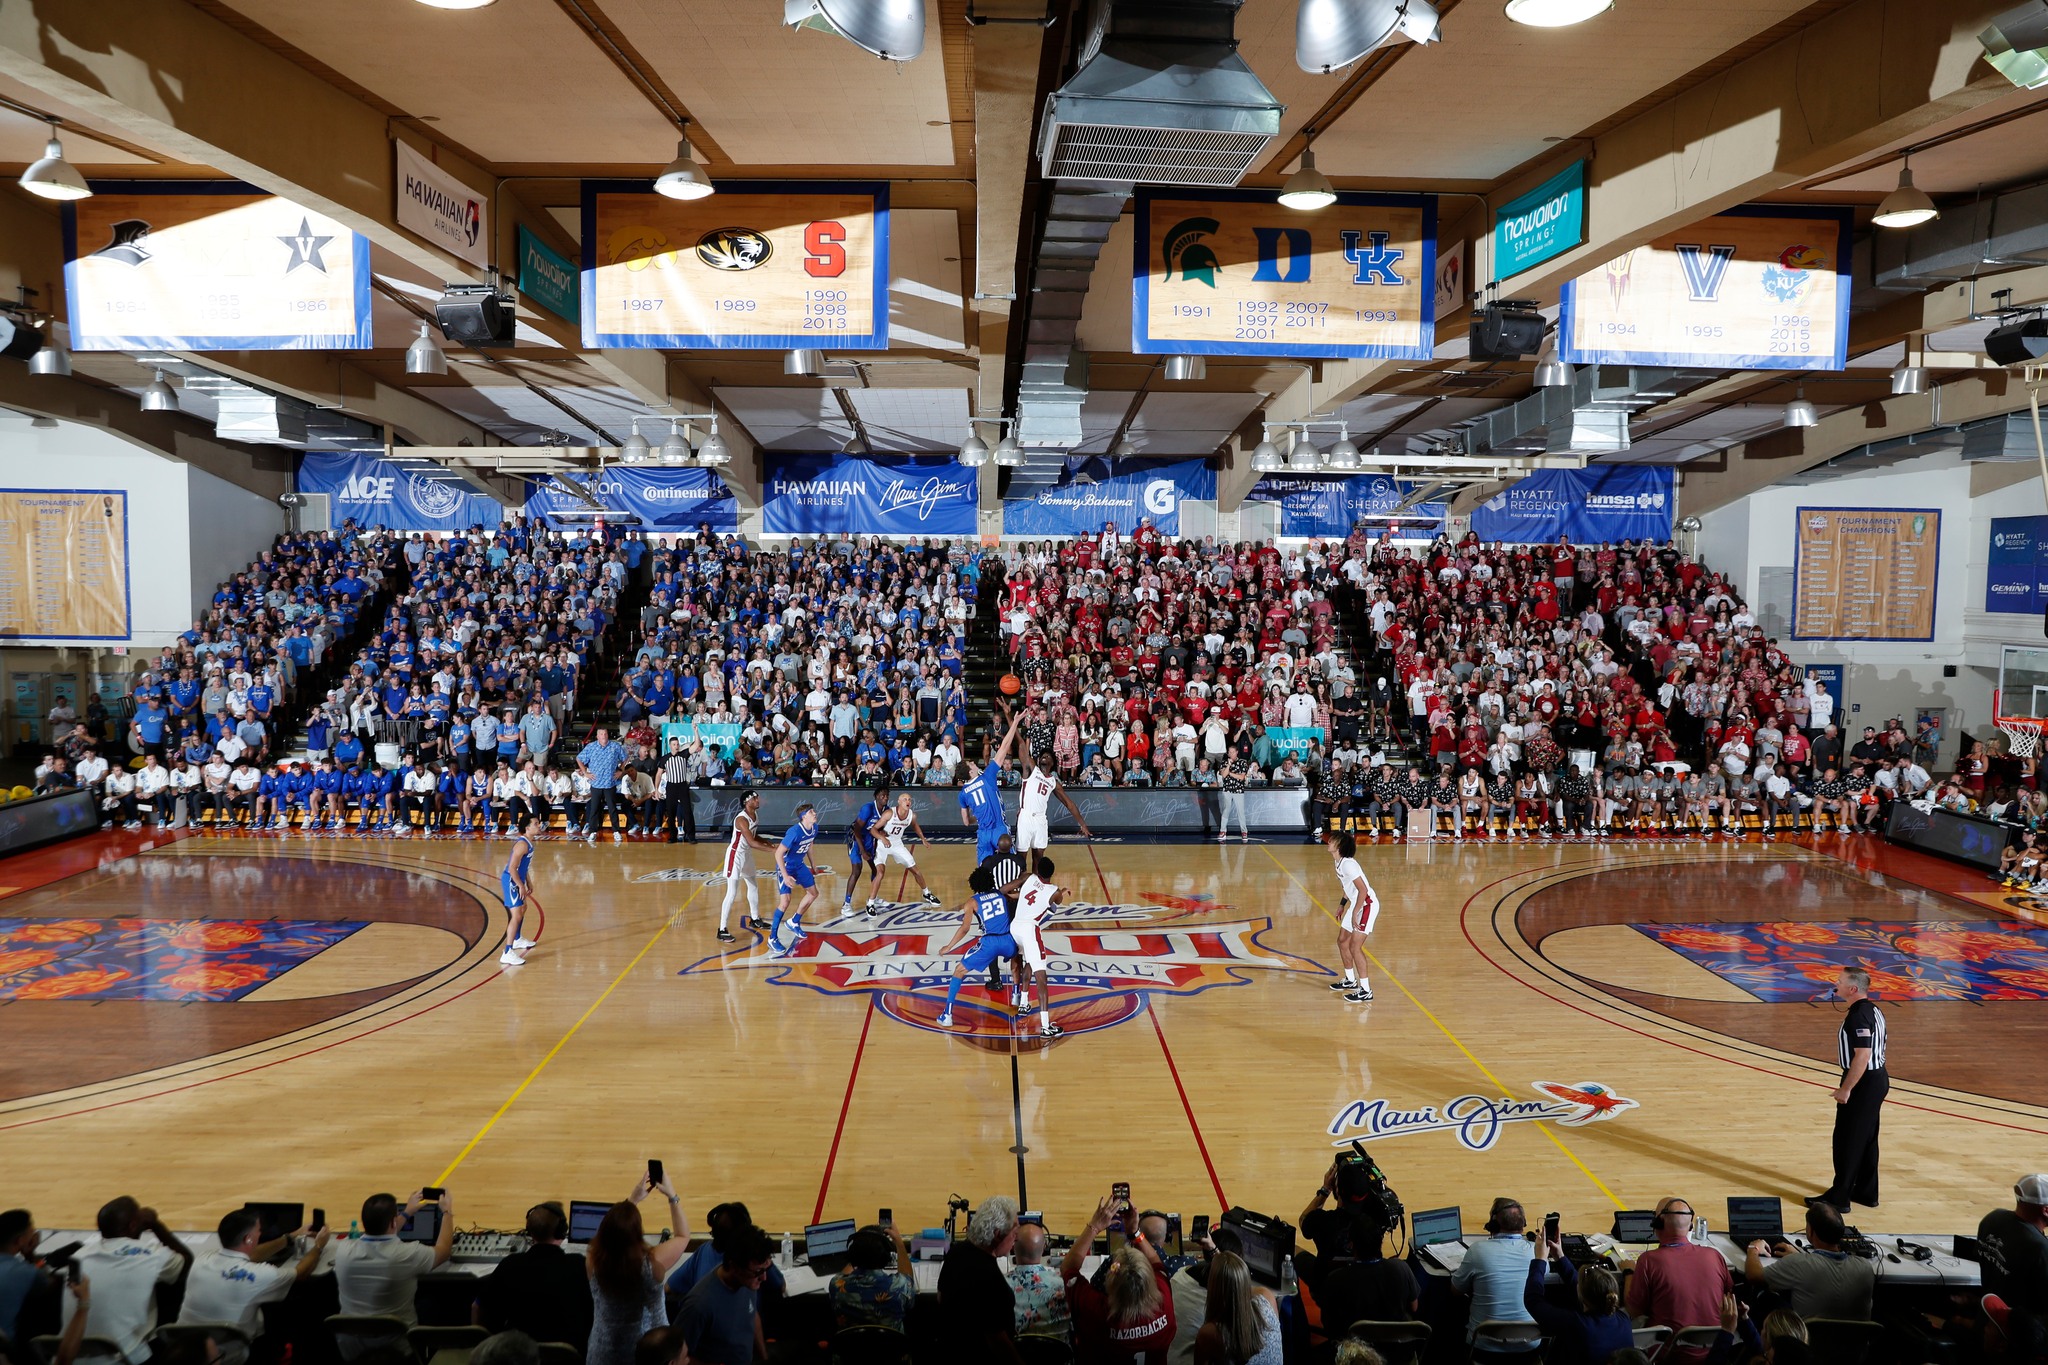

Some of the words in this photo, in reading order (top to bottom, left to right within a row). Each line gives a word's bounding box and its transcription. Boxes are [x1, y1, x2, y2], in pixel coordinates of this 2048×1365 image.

[405, 173, 465, 227] HAWAIIAN
[1504, 192, 1568, 244] hawaiian
[414, 218, 461, 242] AIRLINES
[1514, 224, 1555, 253] SPRINGS
[295, 237, 316, 261] V
[804, 221, 846, 278] S
[527, 242, 571, 294] hawaiian
[805, 291, 847, 302] 1990
[289, 300, 327, 312] 1986
[622, 300, 663, 311] 1987
[714, 300, 756, 311] 1989
[805, 304, 847, 316] 1998
[1173, 305, 1212, 317] 1991
[1237, 301, 1278, 313] 1992
[1286, 303, 1329, 314] 2007
[1237, 315, 1278, 327] 1997
[1285, 316, 1326, 327] 2011
[1355, 310, 1397, 322] 1993
[1773, 315, 1810, 327] 1996
[802, 318, 847, 329] 2013
[1599, 323, 1636, 335] 1994
[1235, 328, 1276, 340] 2001
[1685, 326, 1723, 338] 1995
[1770, 329, 1810, 340] 2015
[1768, 342, 1810, 353] 2019
[338, 473, 395, 499] ACE
[774, 480, 865, 495] HAWAIIAN
[1296, 480, 1345, 492] WESTIN
[880, 480, 917, 506] Maui
[919, 476, 967, 521] Jim
[1144, 480, 1175, 514] G
[1511, 490, 1553, 499] HYATT
[1586, 492, 1635, 504] hmsa
[1038, 494, 1084, 510] Tommy
[1082, 495, 1133, 507] Bahama
[1510, 501, 1566, 511] REGENCY
[1836, 517, 1902, 525] TOURNAMENT
[1991, 583, 2024, 592] GEMINI
[1036, 783, 1049, 796] 15
[970, 788, 986, 807] 11
[890, 827, 901, 835] 13
[1024, 889, 1038, 906] 4
[981, 898, 1005, 920] 23
[1332, 1100, 1438, 1134] Maui
[1447, 1096, 1573, 1149] Jim
[1109, 1314, 1168, 1340] RAZORBACKS
